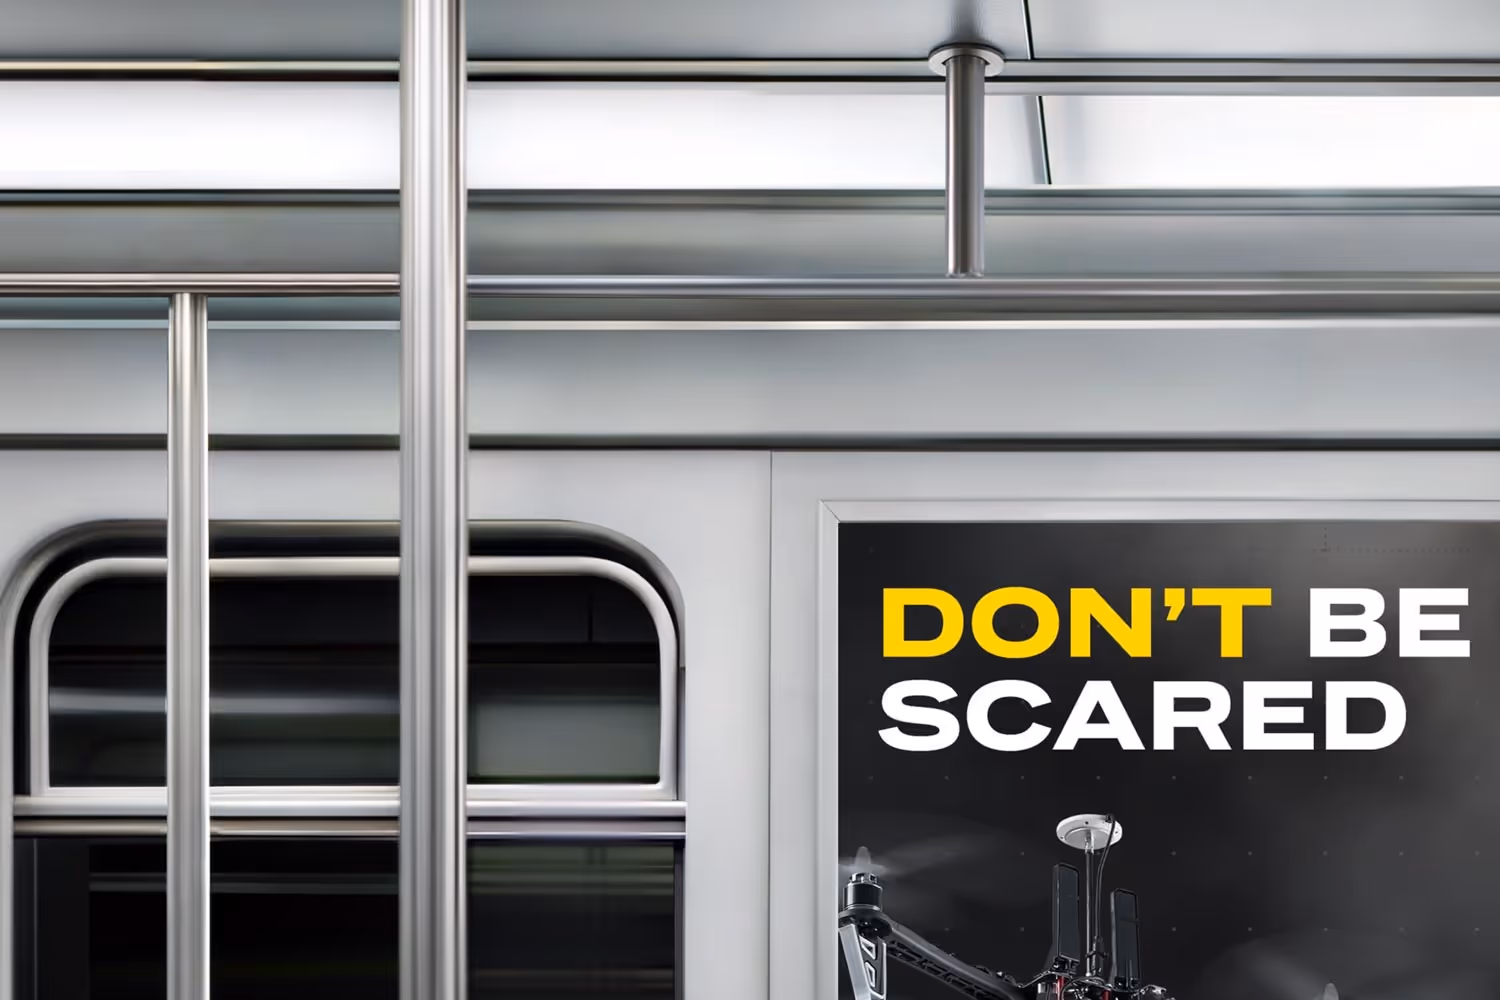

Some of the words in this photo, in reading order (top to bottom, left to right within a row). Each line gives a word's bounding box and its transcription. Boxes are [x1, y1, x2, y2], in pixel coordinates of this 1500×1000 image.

[883, 586, 1272, 659] DON’T
[1310, 588, 1471, 658] BE
[878, 679, 1407, 752] SCARED
